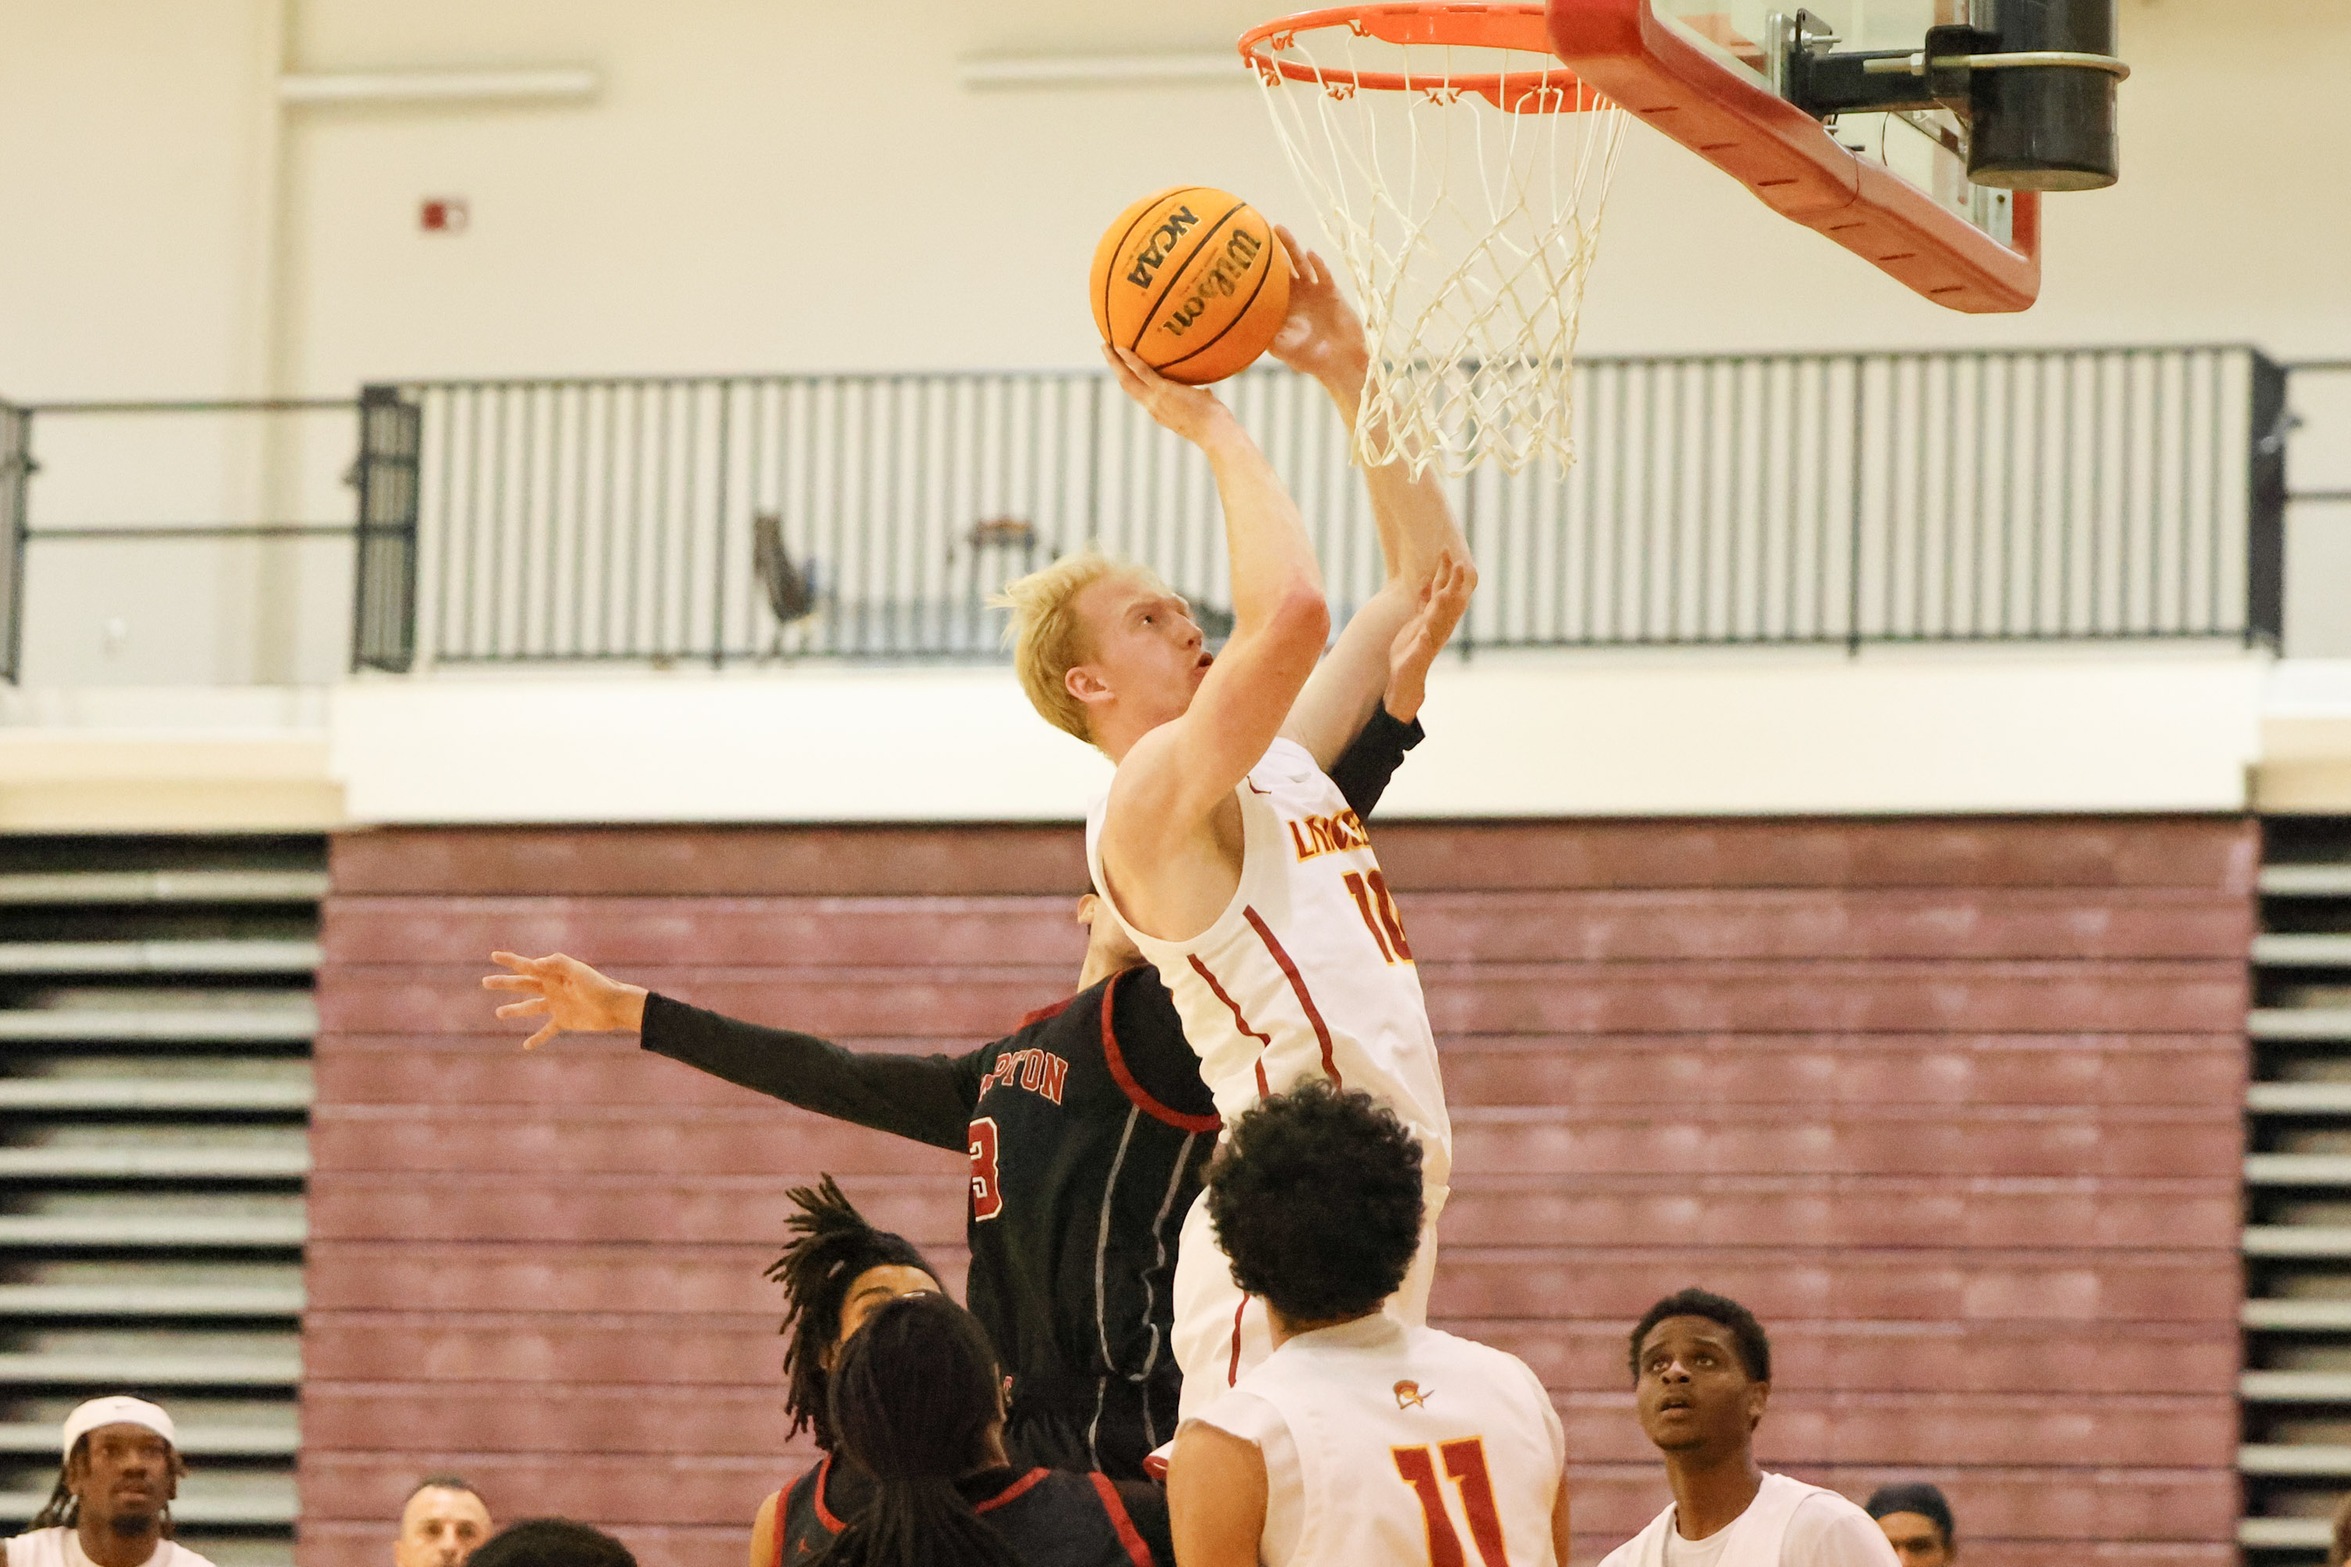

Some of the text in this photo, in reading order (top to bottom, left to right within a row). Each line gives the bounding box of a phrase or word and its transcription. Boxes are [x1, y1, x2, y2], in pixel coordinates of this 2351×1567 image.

[1127, 205, 1201, 290] NCAA
[1163, 228, 1262, 336] Wilson
[1389, 1435, 1511, 1567] 11
